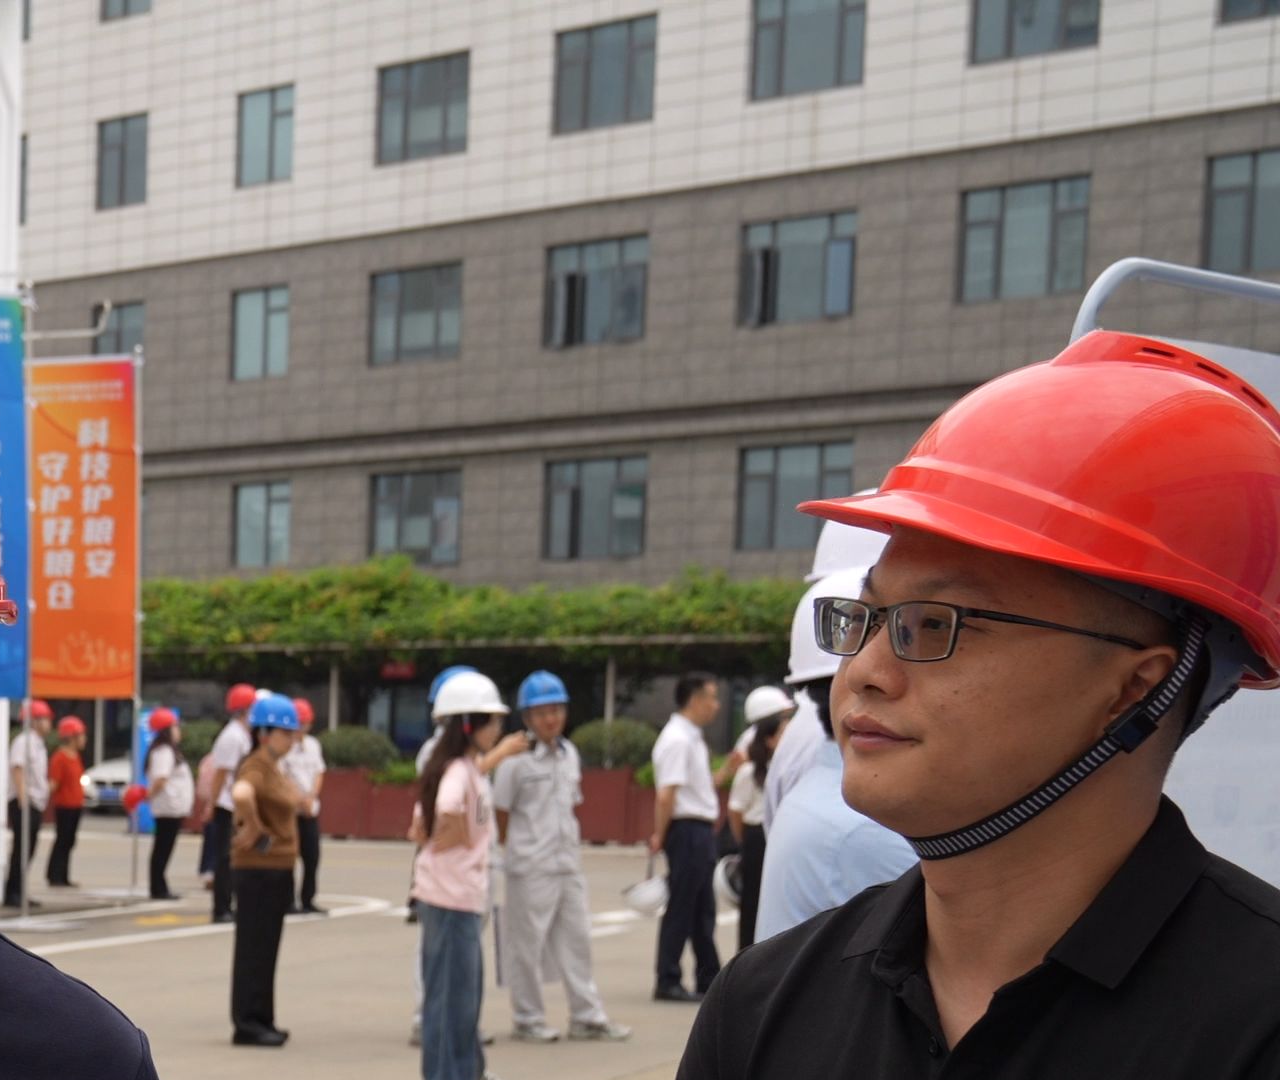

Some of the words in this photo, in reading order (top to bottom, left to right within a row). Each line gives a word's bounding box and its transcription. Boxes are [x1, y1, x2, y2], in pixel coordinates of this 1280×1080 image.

[37, 452, 75, 610] 守护好粮仓
[77, 417, 116, 578] 科技护粮安
